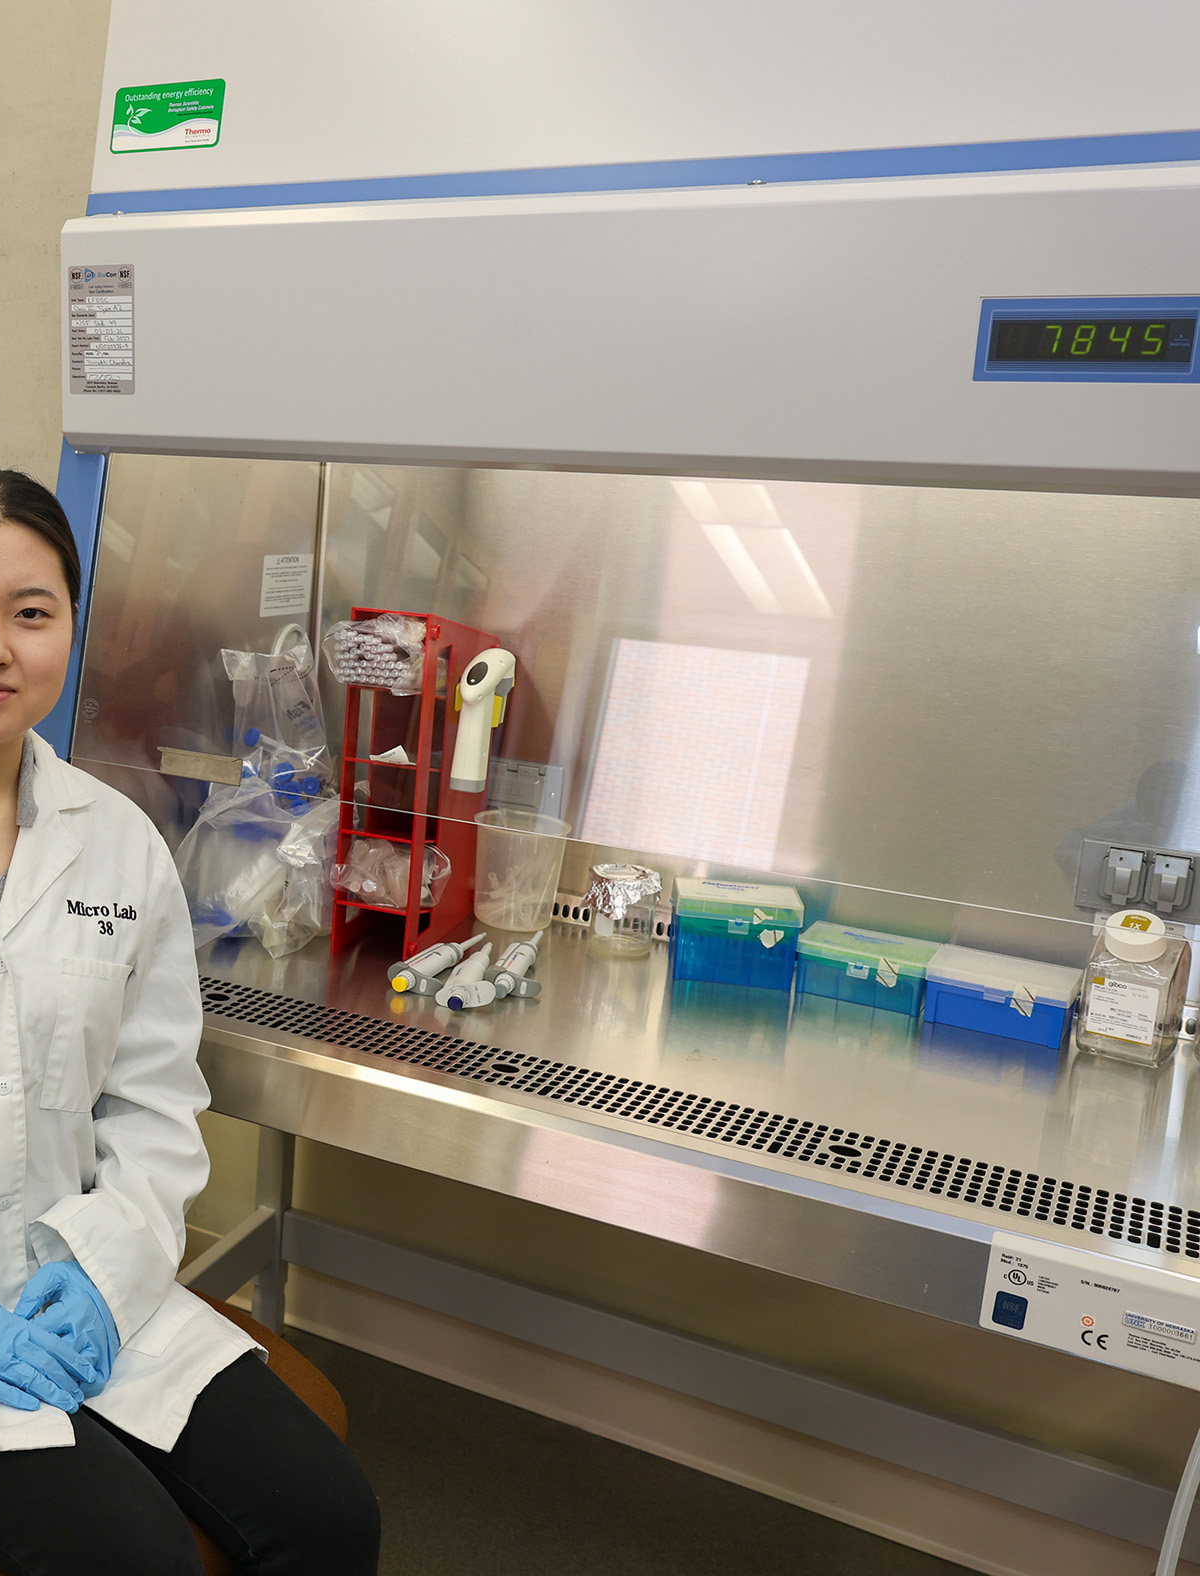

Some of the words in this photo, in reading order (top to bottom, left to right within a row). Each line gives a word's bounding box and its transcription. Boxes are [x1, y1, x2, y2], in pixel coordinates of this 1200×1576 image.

[124, 91, 161, 102] Outstanding
[162, 89, 183, 100] energy
[184, 87, 215, 98] efficiency
[71, 271, 82, 280] NSF
[119, 270, 130, 278] NSF
[1045, 324, 1166, 355] 7845
[66, 899, 110, 917] Micro
[113, 902, 137, 921] Lab
[97, 920, 114, 936] 38
[1129, 922, 1142, 930] 1X
[1108, 980, 1128, 990] gibco
[1012, 1272, 1021, 1282] UL
[1002, 1300, 1020, 1312] NSF
[1125, 1317, 1146, 1328] UNK
[1125, 1313, 1156, 1324] UNIVERSITY
[1165, 1324, 1195, 1334] NEBRASKA
[1081, 1330, 1109, 1350] CE
